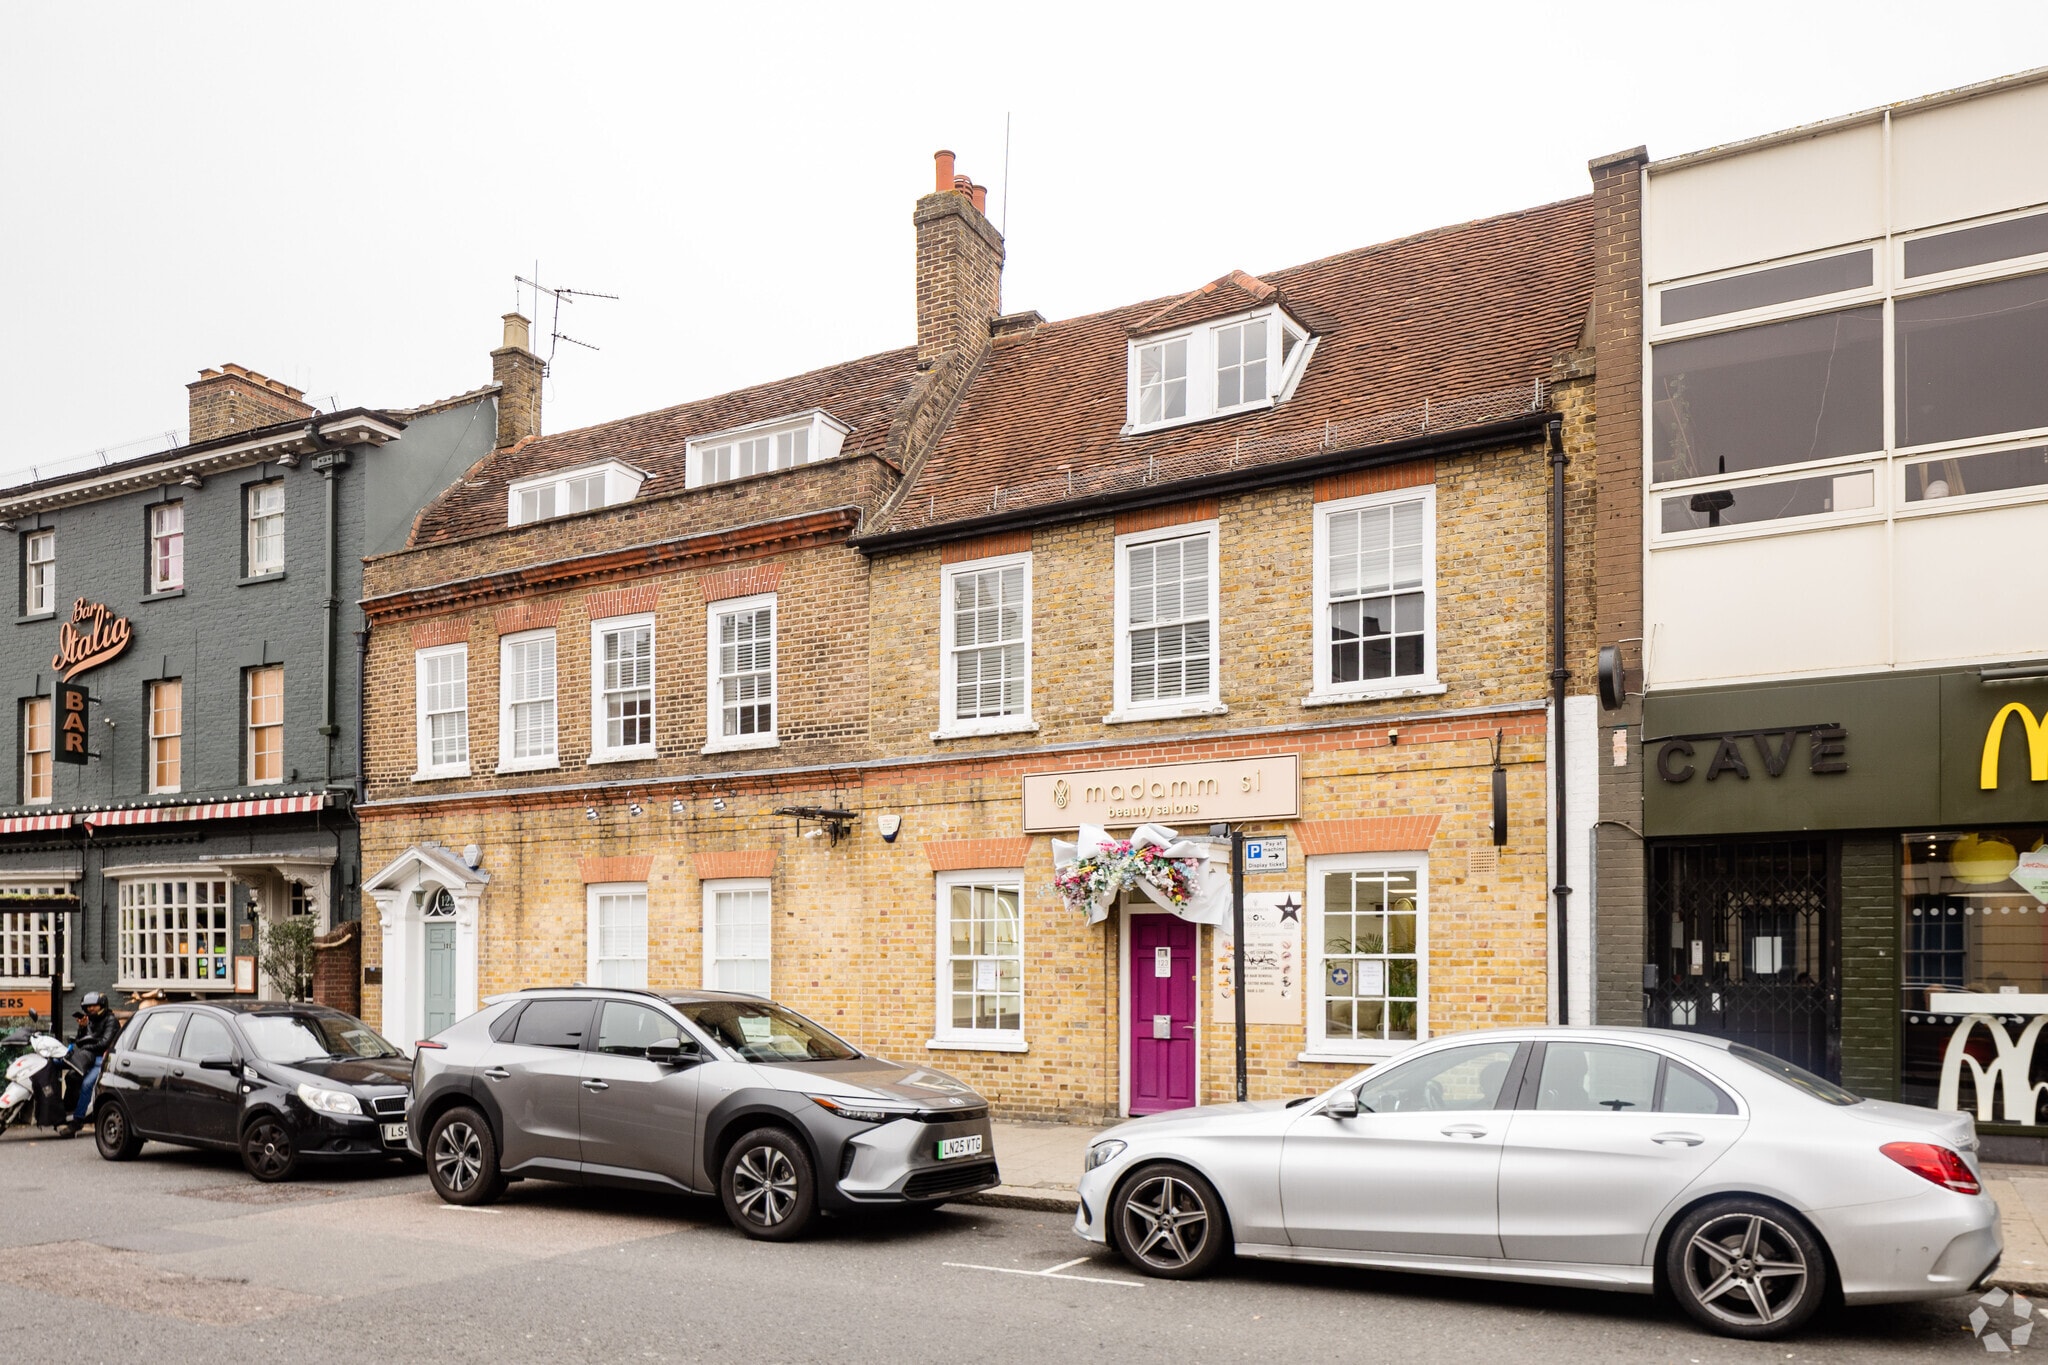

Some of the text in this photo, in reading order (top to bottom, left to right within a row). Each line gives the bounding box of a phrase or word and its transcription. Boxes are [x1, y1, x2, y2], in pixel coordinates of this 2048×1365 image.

[71, 597, 99, 624] Bar
[51, 603, 132, 672] Italia
[62, 690, 86, 753] BAR
[1657, 728, 1850, 783] CAVE
[1085, 776, 1219, 803] madamm
[1107, 803, 1199, 819] beauty salons
[1250, 845, 1260, 858] P
[1158, 959, 1169, 967] 123
[0, 998, 24, 1008] ERS
[944, 1137, 981, 1155] LN25 VTG
